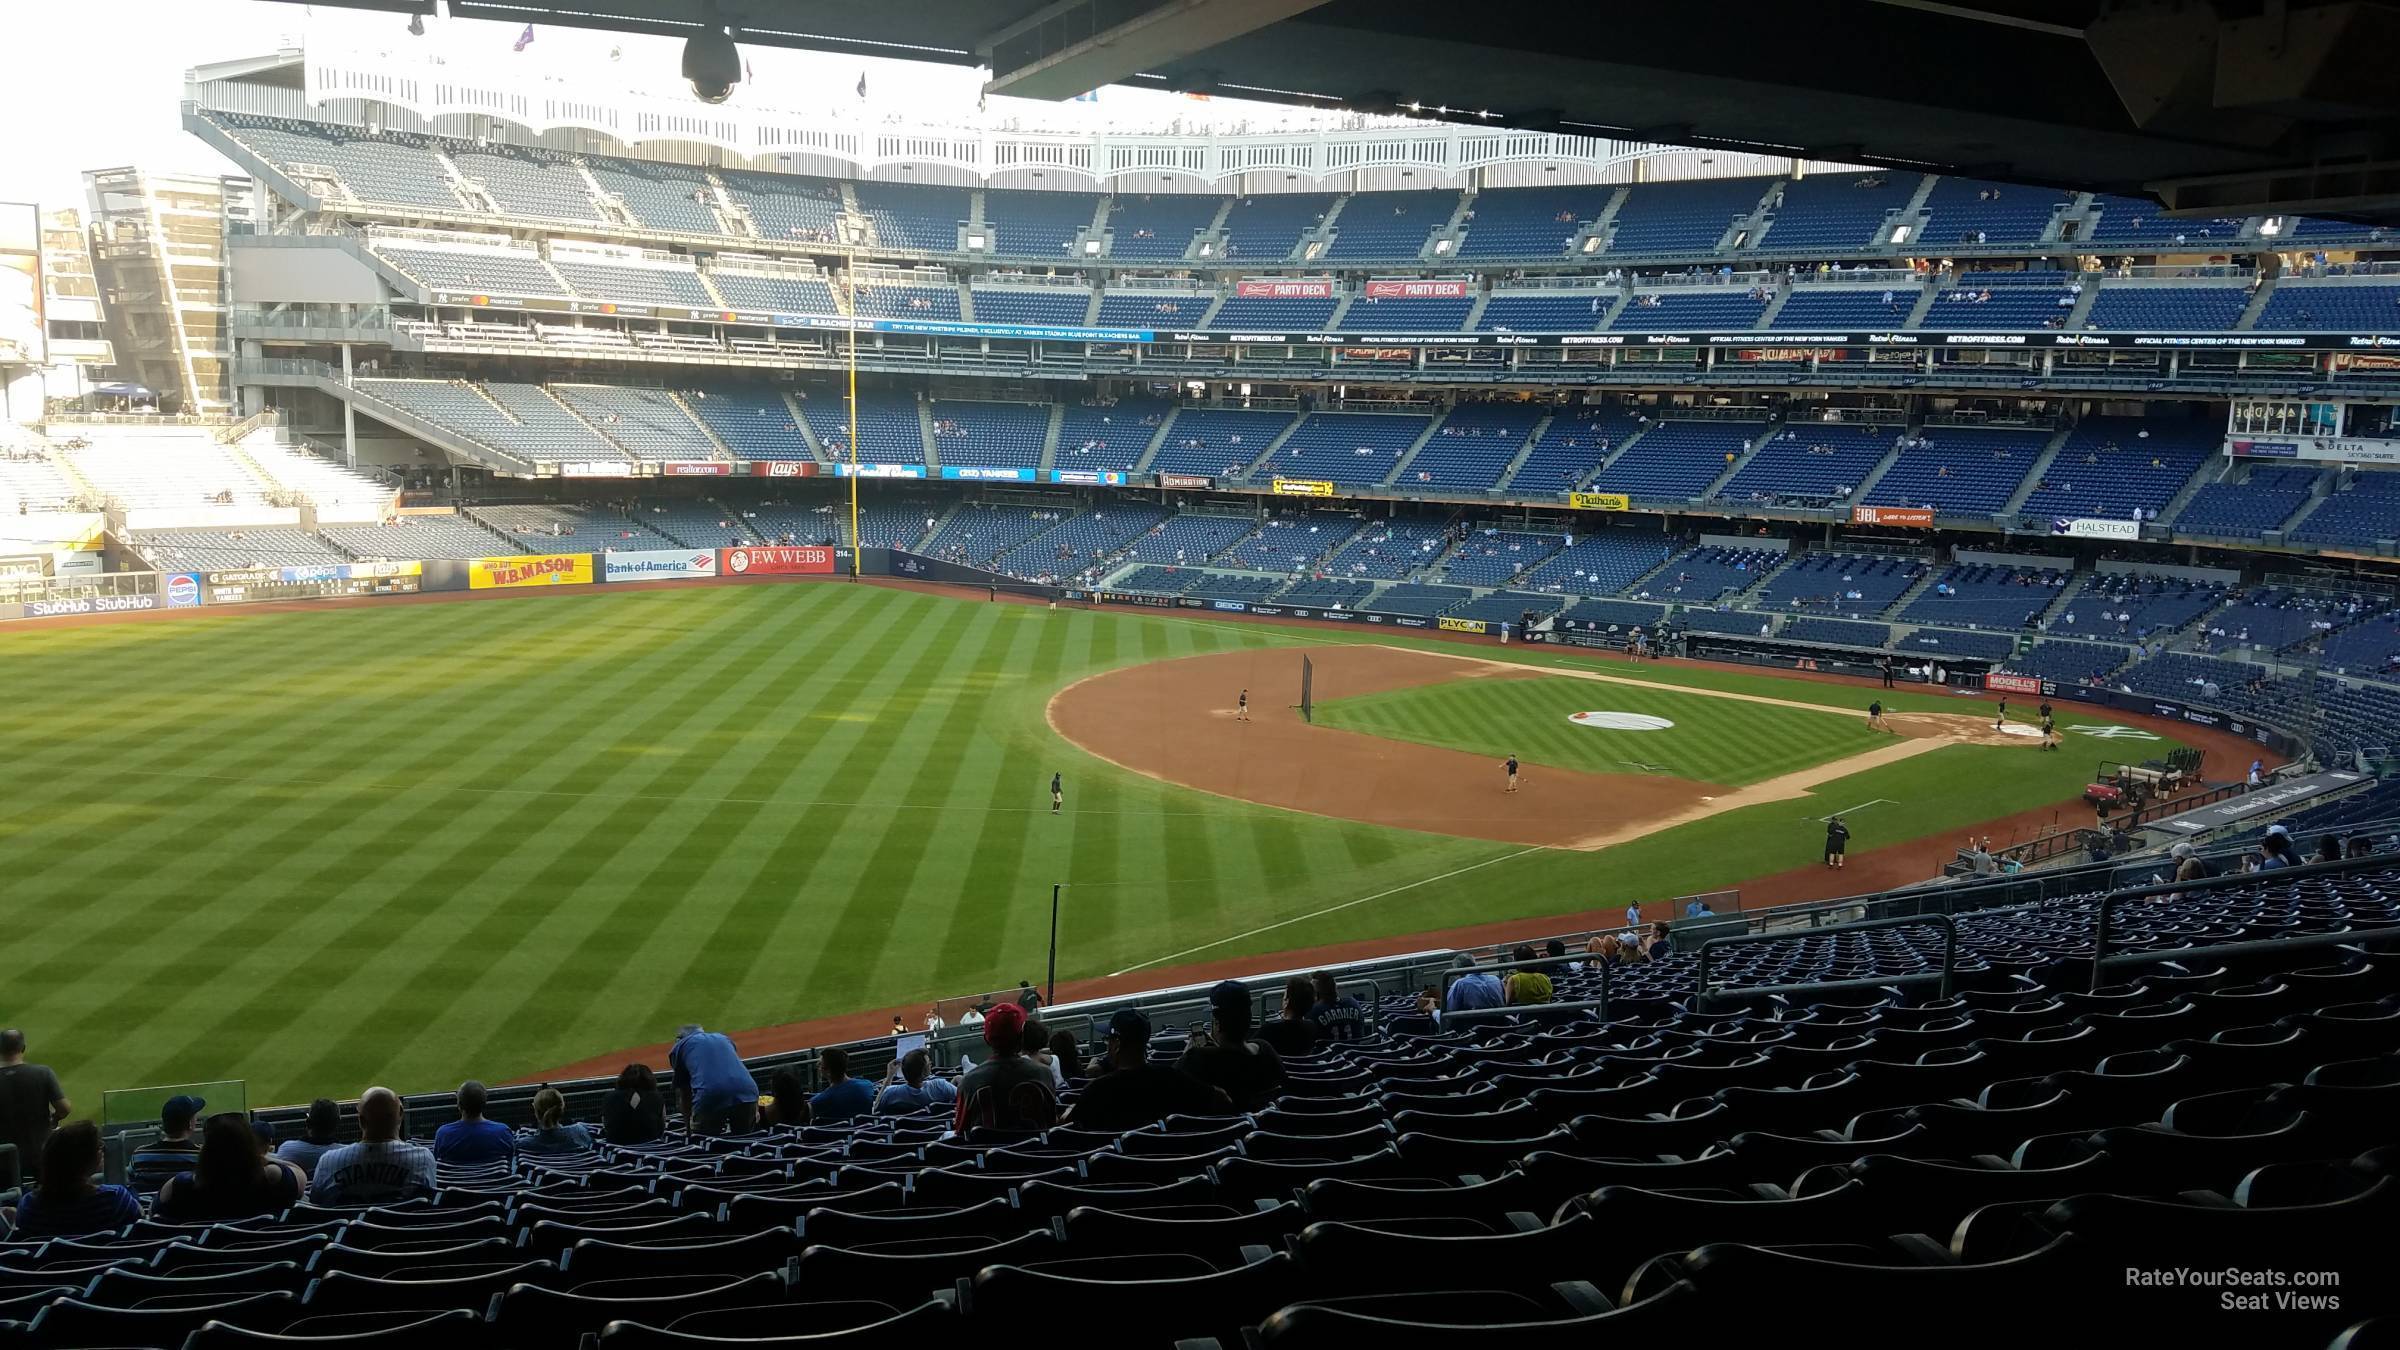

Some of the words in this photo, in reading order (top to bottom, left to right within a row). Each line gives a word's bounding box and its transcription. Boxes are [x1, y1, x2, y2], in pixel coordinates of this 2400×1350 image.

[1275, 285, 1300, 295] PARTY
[1303, 285, 1325, 295] DECK
[1406, 284, 1433, 295] PARTY
[1436, 284, 1459, 295] DECK
[811, 319, 856, 329] BLEACHERS
[858, 321, 874, 329] BAR
[980, 327, 1014, 335] EXCLUSIVELY
[1561, 336, 1624, 344] RETROFITNESS.COM
[1870, 334, 1889, 342] Retro
[1947, 335, 2026, 343] RETROFITNESS.COM
[2056, 336, 2077, 344] Retro
[2081, 336, 2109, 344] Fitness
[2350, 337, 2373, 345] Retro
[2328, 443, 2364, 452] DELTA
[677, 464, 718, 474] realtor.com
[770, 462, 799, 476] Lay's
[1163, 476, 1210, 487] ADMIRATION
[1576, 494, 1621, 506] Nathan's
[1857, 508, 1881, 523] JBL
[2076, 522, 2135, 534] HALSTEAD
[751, 550, 777, 564] F.W.
[780, 550, 826, 564] WEBB
[836, 550, 848, 558] 314
[310, 565, 337, 577] pepsi
[607, 561, 633, 573] Bank
[633, 561, 645, 572] of
[646, 560, 687, 571] America
[222, 573, 266, 581] GATORADE
[216, 594, 243, 602] YANKEES
[33, 600, 90, 615] StubHub
[95, 596, 153, 611] StubHub
[1215, 601, 1244, 610] GEICO
[1989, 676, 2036, 688] MODELL'S
[1318, 1007, 1360, 1026] GARDNER
[1331, 1024, 1353, 1041] 11
[334, 1162, 409, 1185] STANTON
